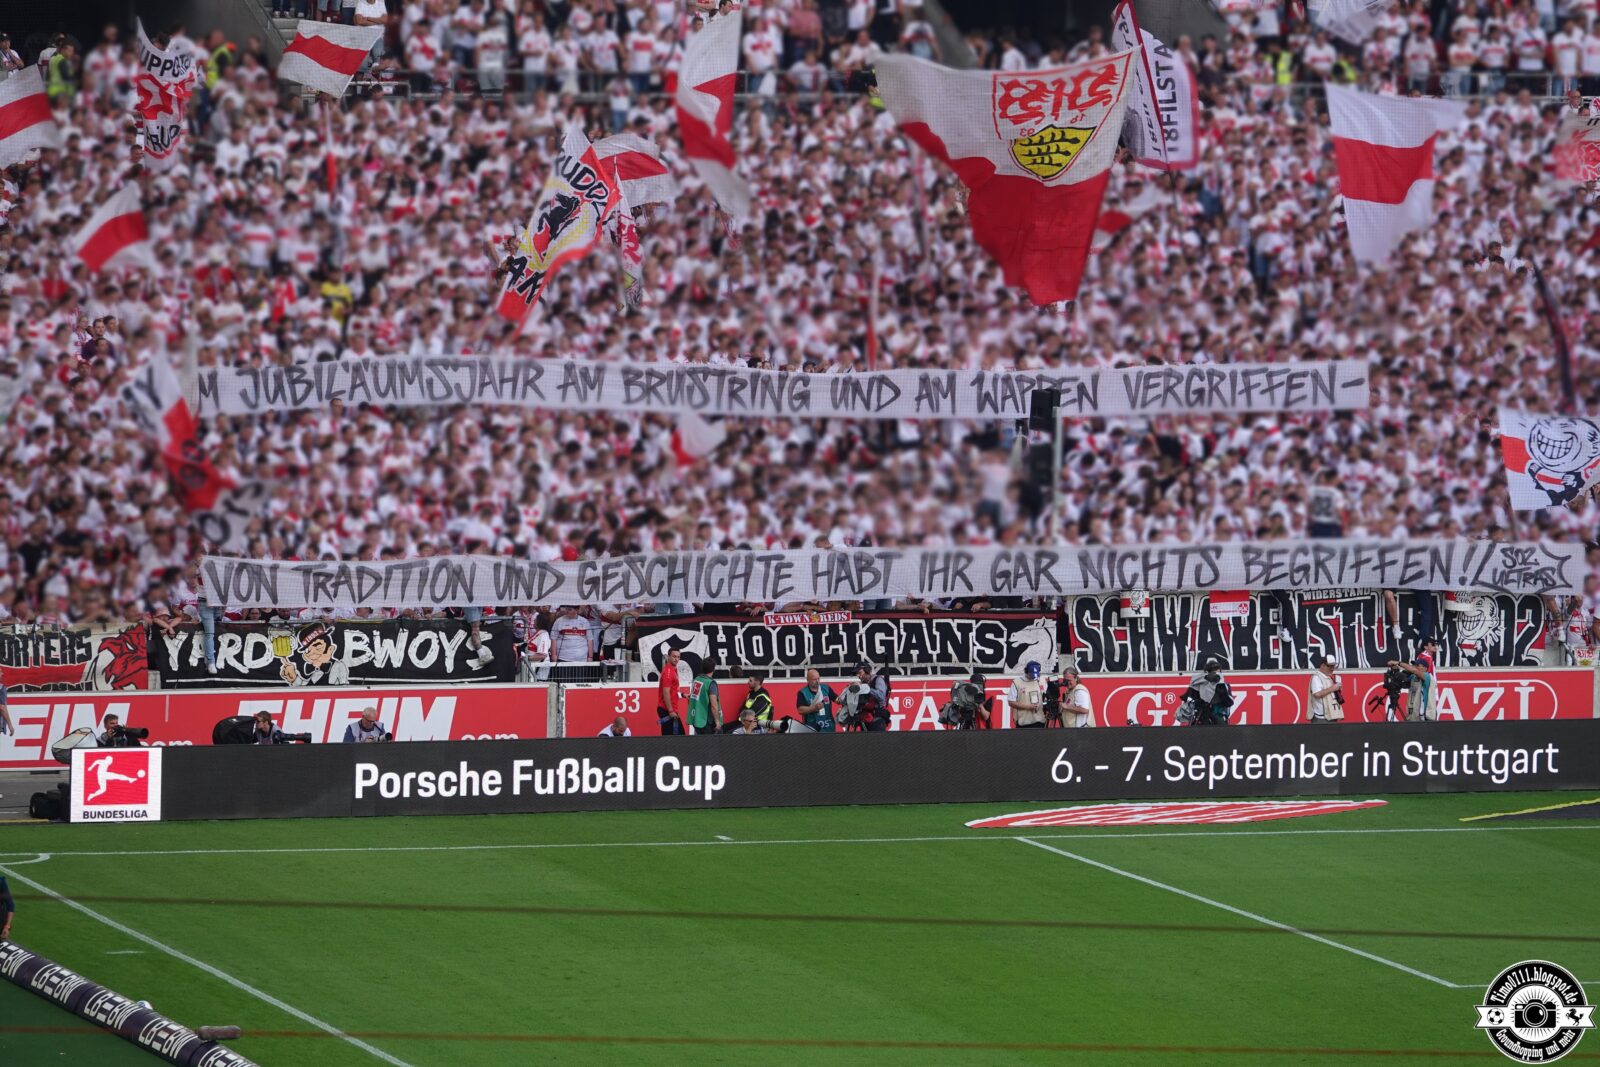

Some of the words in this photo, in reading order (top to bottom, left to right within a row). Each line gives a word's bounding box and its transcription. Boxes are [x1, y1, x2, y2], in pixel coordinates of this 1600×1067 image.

[236, 356, 546, 410] JUBILÄUMSJAHR
[555, 361, 607, 403] AM
[620, 366, 811, 413] BRUSTRING
[830, 374, 902, 412] UND
[915, 371, 956, 414] AM
[204, 559, 280, 606] VON
[291, 559, 477, 604] TRADITION
[493, 557, 565, 602] UND
[577, 552, 795, 600] GESCHICHTE
[811, 551, 904, 597] HABT
[919, 551, 974, 593] IHR
[990, 551, 1063, 593] GAR
[1078, 546, 1223, 590] NICHTS
[1492, 566, 1557, 590] ULTRAS
[820, 612, 848, 623] REDS
[703, 619, 1007, 668] HOOLIGANS
[614, 689, 641, 714] 33
[355, 760, 503, 799] Porsche
[512, 756, 645, 796] Fußball
[655, 755, 726, 801] Cup
[1051, 747, 1083, 783] 6.
[1122, 746, 1152, 782] 7.
[1163, 743, 1354, 790] September
[1364, 742, 1391, 777] in
[1402, 740, 1560, 785] Stuttgart
[83, 809, 149, 820] BUNDESLIGA
